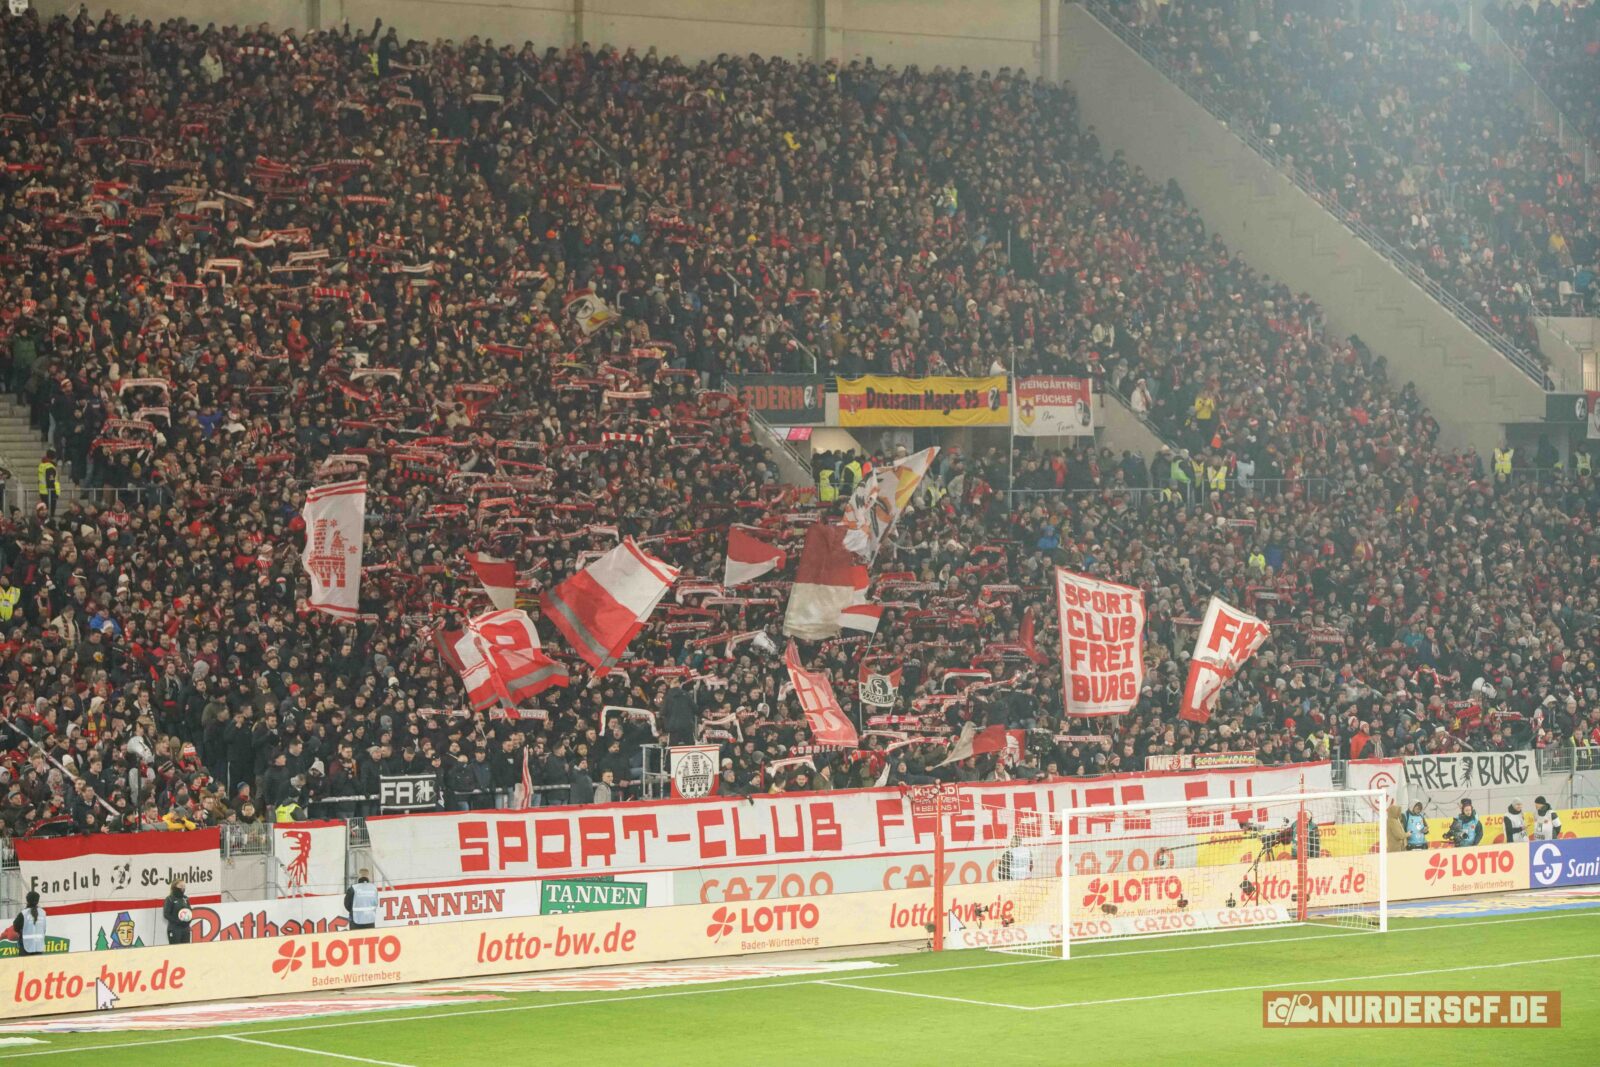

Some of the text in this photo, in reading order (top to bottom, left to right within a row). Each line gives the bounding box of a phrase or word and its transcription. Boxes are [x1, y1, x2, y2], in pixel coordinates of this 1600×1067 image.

[866, 387, 921, 410] Dreisam
[924, 389, 960, 415] Magic
[1064, 583, 1133, 614] SPORT
[1067, 608, 1137, 643] CLUB
[1069, 639, 1134, 672] FREI
[1071, 671, 1136, 703] BURG
[1477, 749, 1529, 785] BURG
[457, 801, 843, 872] SPORT-CLUB
[1452, 849, 1514, 877] LOTTO
[31, 865, 213, 893] Fanclub SC-Junkies
[1112, 875, 1183, 903] LOTTO
[1452, 878, 1514, 891] Baden-Württemberg
[380, 888, 505, 921] TANNEN
[546, 883, 643, 906] TANNEN
[741, 903, 819, 933] LOTTO
[1134, 913, 1196, 932] CAZOO
[1217, 906, 1277, 925] CAZOO
[312, 934, 401, 968] LOTTO
[477, 922, 636, 963] lotto-bw.de
[741, 935, 819, 950] Baden-Württemberg
[14, 959, 186, 1003] lotto-bw.de
[312, 970, 401, 986] Baden-Württemberg
